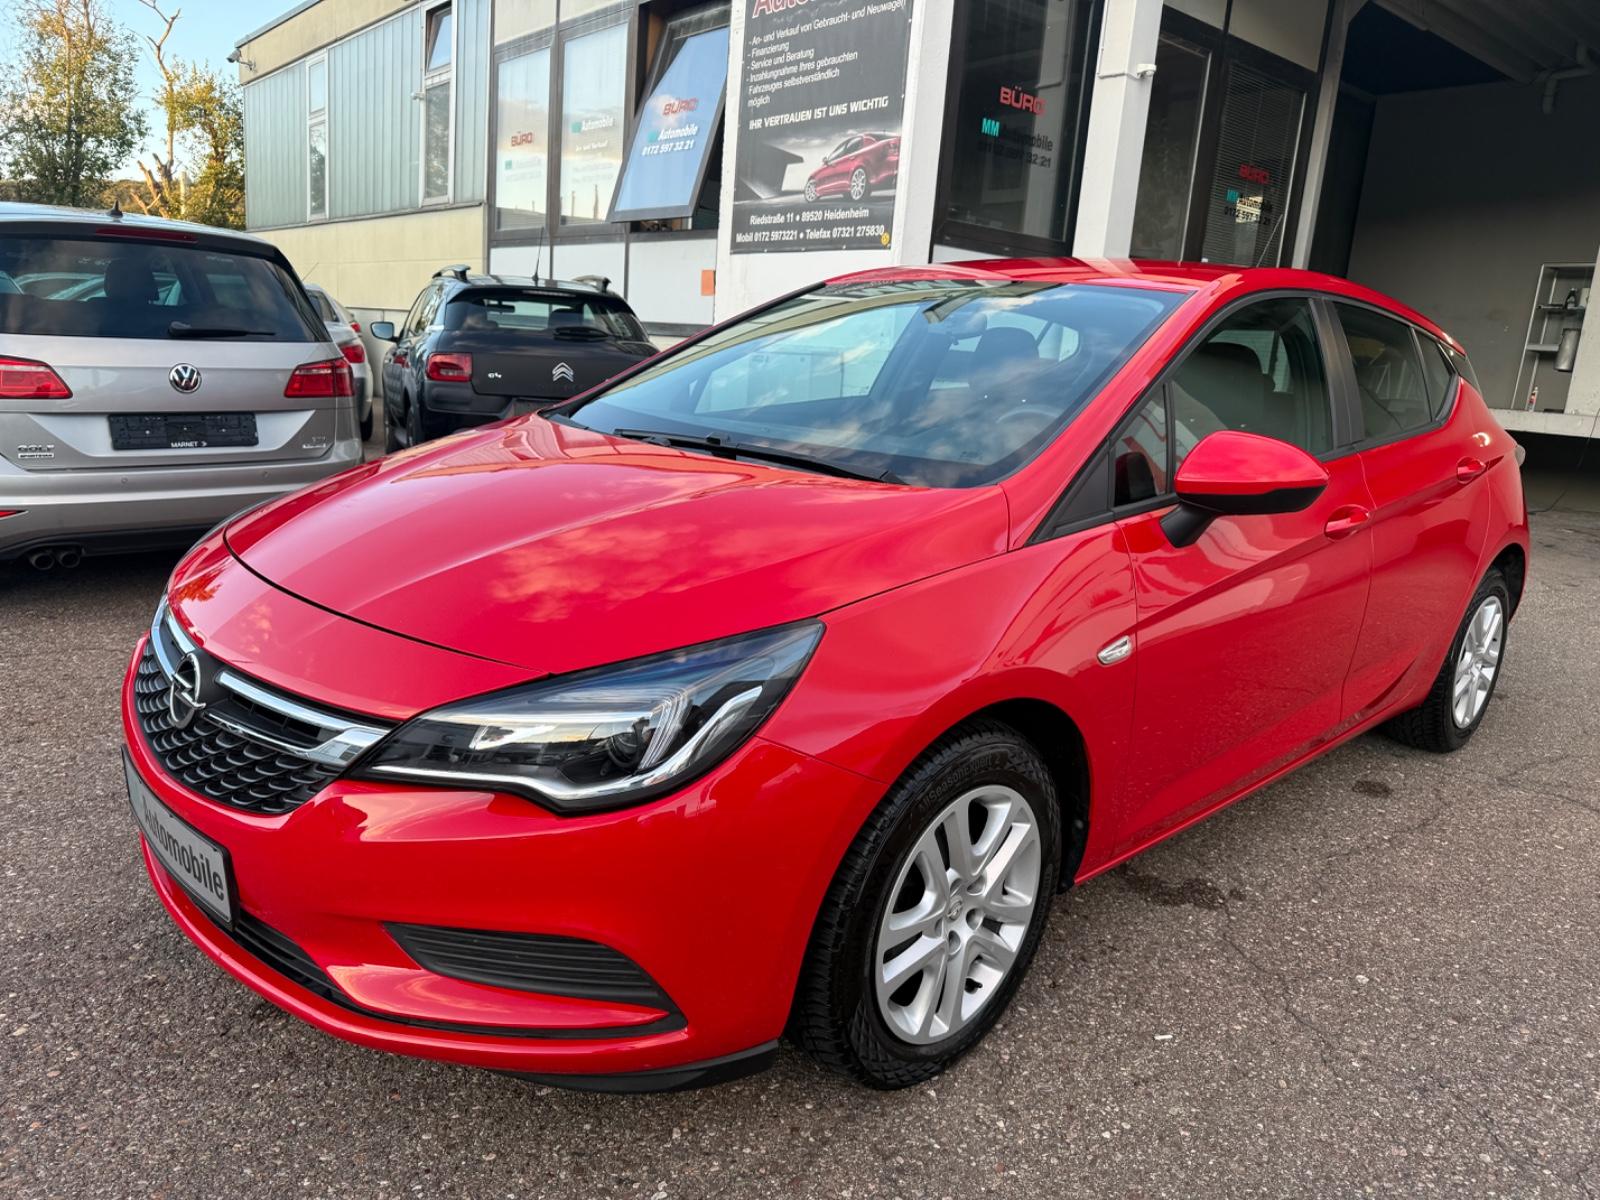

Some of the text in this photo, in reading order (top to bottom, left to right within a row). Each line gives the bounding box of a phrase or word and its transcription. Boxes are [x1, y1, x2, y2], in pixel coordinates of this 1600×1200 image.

[763, 31, 775, 42] und
[776, 24, 800, 39] Verkauf
[800, 22, 812, 32] von
[851, 6, 866, 20] und
[751, 42, 789, 58] Finanzierung
[751, 48, 815, 70] Service und Beratung
[799, 60, 816, 72] Ihres
[816, 51, 858, 70] gebrauchten
[748, 67, 840, 95] Fahrzeuges selbstverständlich
[748, 94, 771, 108] möglich
[1000, 86, 1047, 116] BÜRO
[749, 96, 889, 130] IHR VERTRAUEN IST UNS WICHTIG
[981, 118, 1000, 137] MM
[511, 130, 533, 147] BÜRO
[750, 208, 869, 225] Riedstraße 11 89520 Heidenheim
[736, 225, 885, 243] Mobil 0172 5973221 Telefax 07321 275830
[142, 795, 225, 901] Automobile
